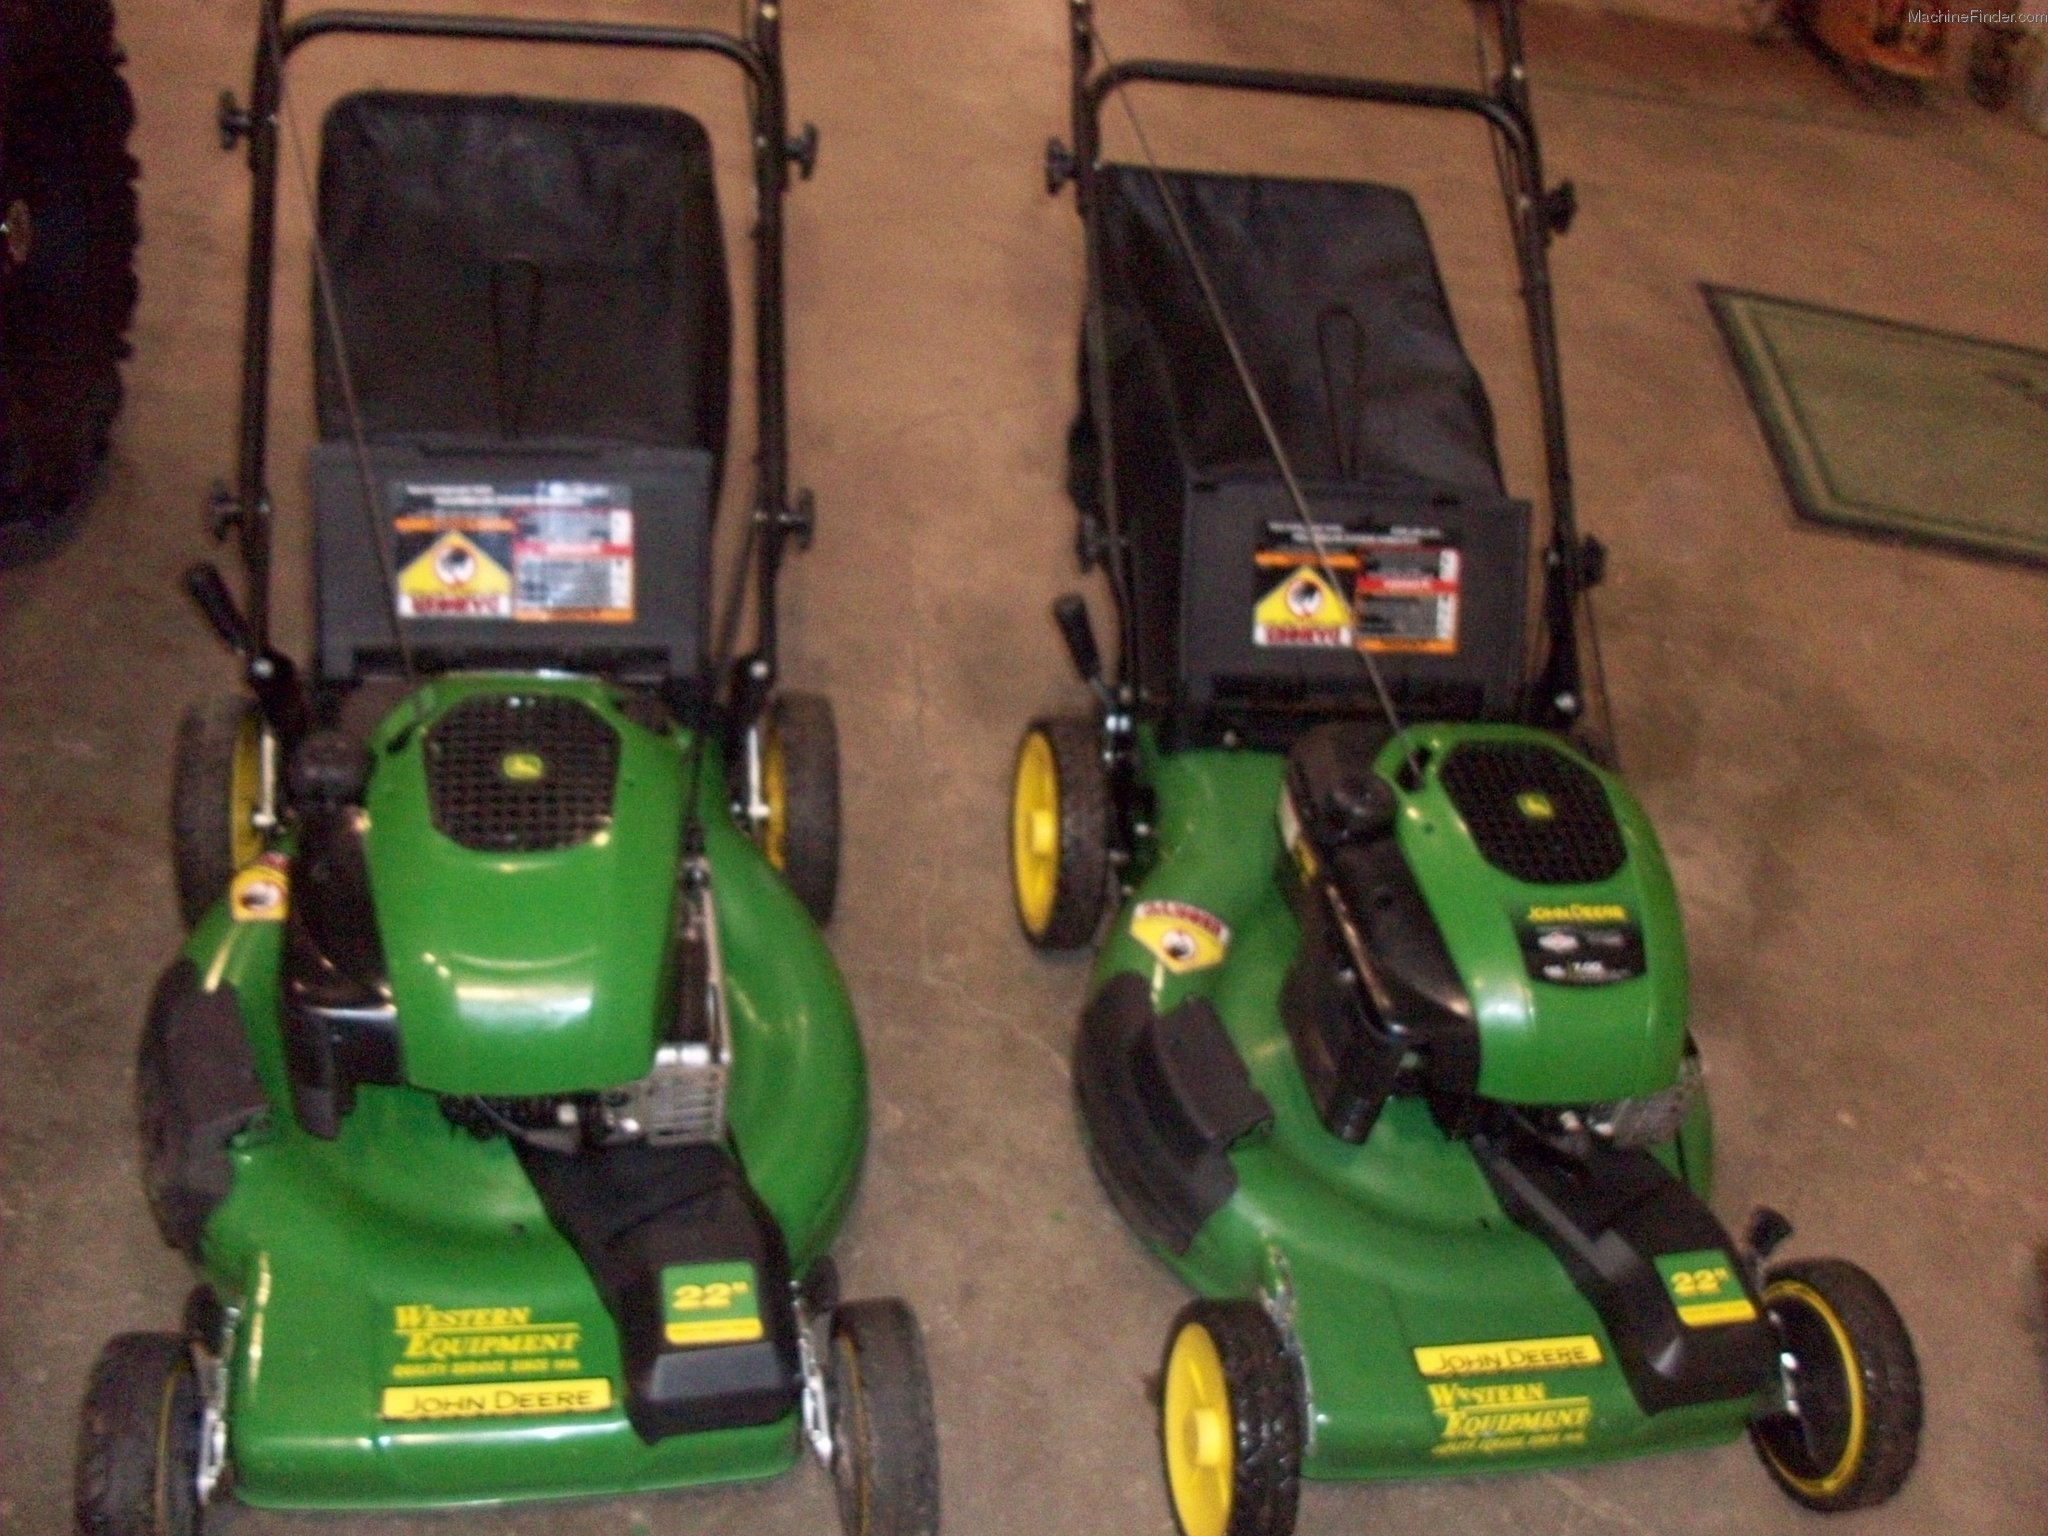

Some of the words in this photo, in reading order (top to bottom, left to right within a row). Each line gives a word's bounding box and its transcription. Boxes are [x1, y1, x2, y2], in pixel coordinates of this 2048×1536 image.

[672, 1281, 748, 1311] 22"
[404, 1332, 580, 1359] EQUIPMENT
[1438, 1351, 1501, 1372] JOHN
[1506, 1345, 1588, 1365] DEERE
[405, 1395, 486, 1414] JOHN
[494, 1390, 594, 1409] DEERE
